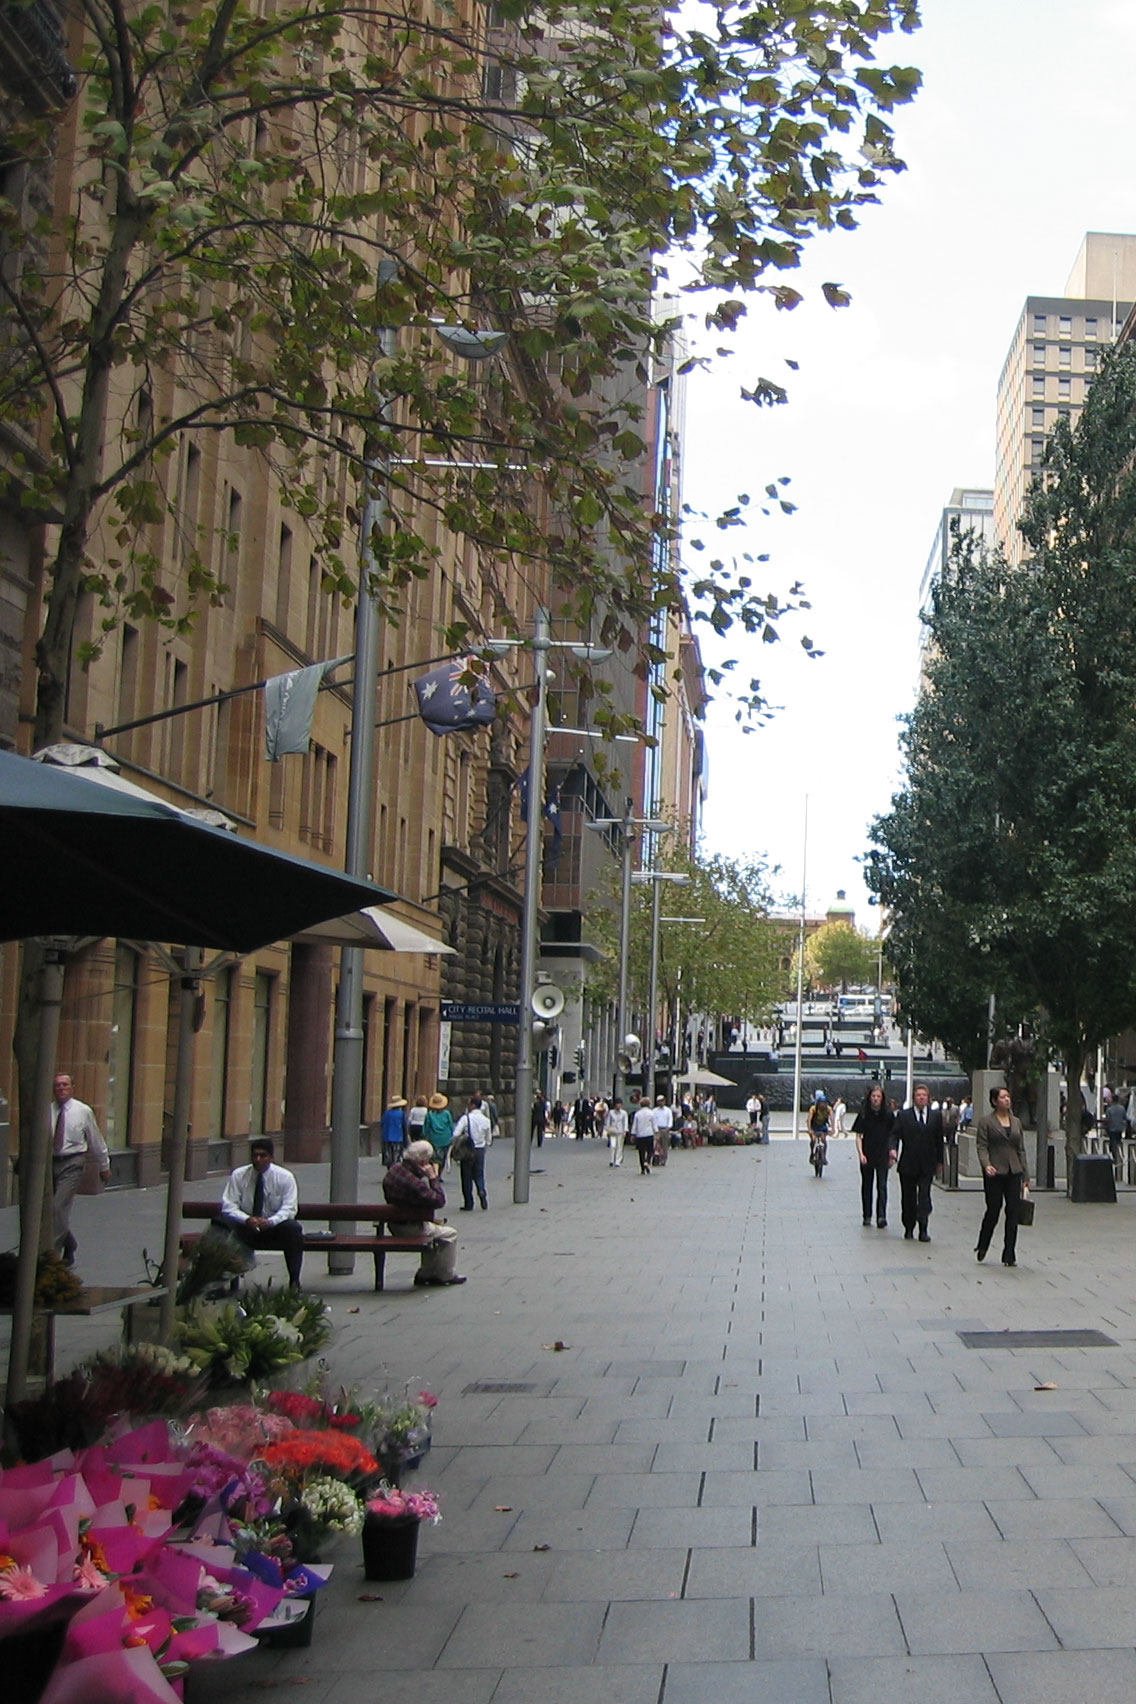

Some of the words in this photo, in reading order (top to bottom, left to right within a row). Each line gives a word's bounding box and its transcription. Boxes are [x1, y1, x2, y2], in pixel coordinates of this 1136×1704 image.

[448, 1005, 466, 1014] CITY
[468, 1006, 496, 1015] RECITAL
[498, 1006, 517, 1016] HALL
